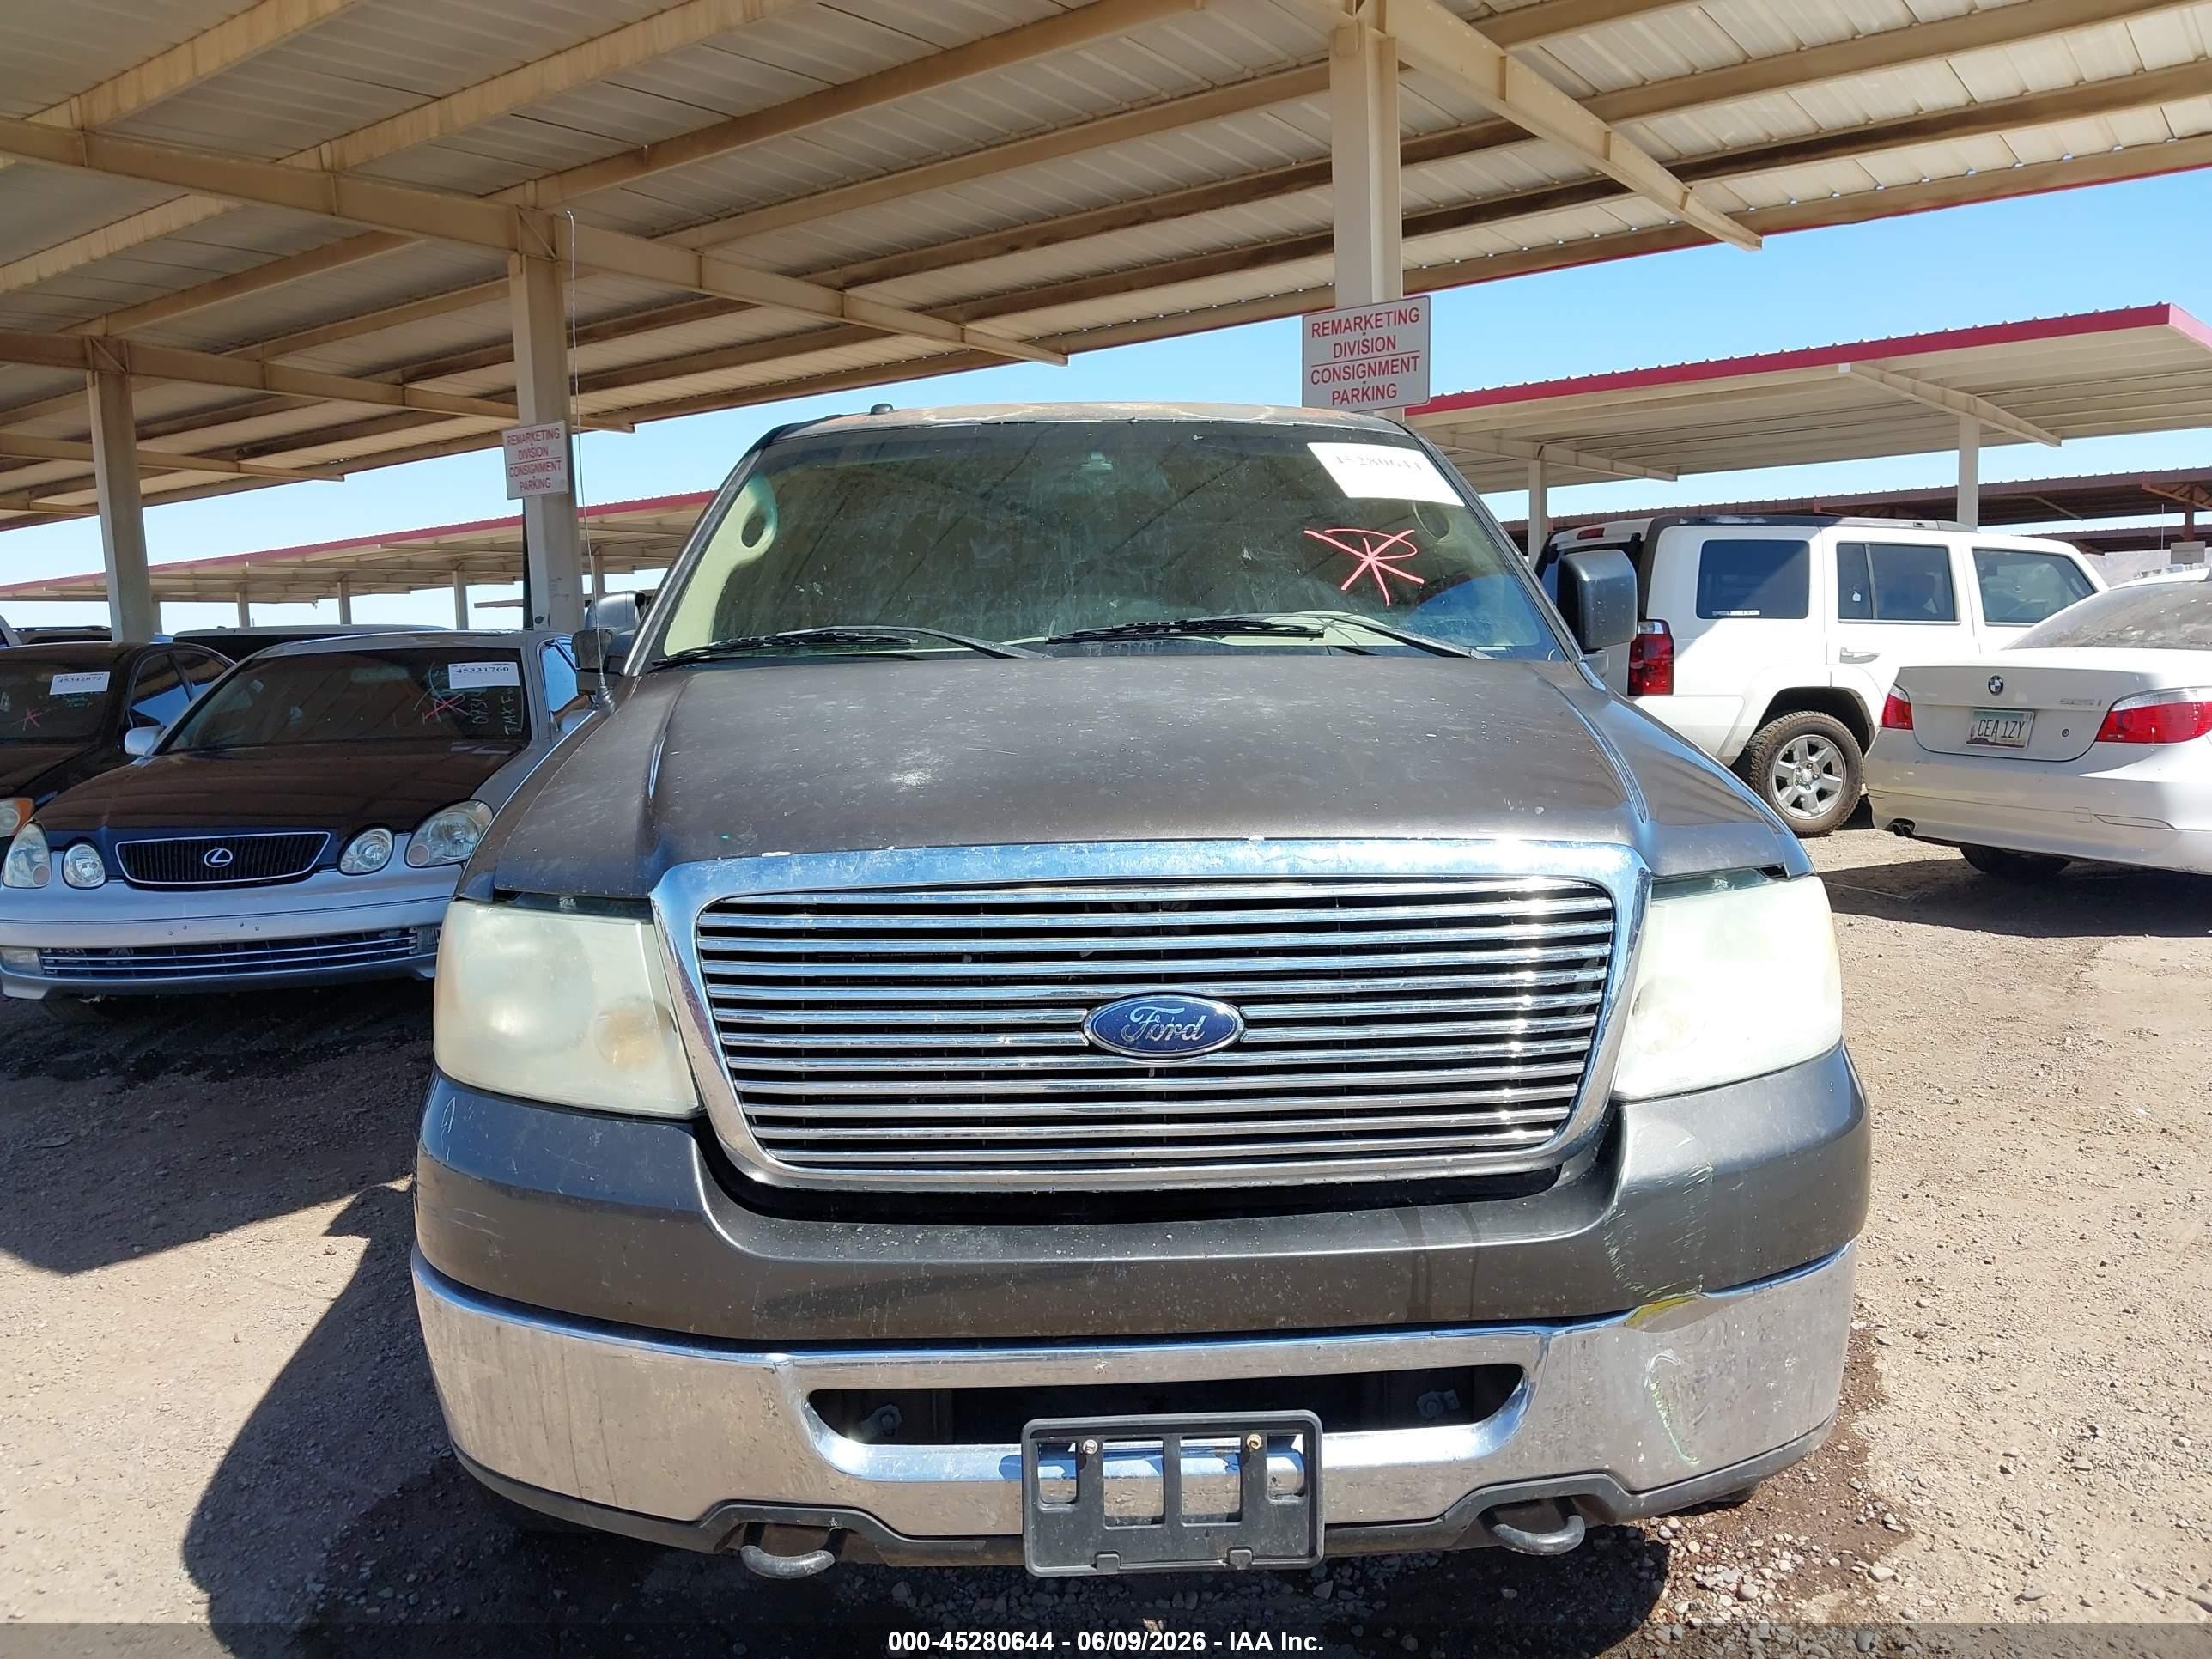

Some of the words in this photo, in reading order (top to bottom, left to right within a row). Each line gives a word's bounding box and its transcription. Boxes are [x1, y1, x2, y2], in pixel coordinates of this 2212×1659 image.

[1311, 307, 1419, 338] REMARKETING
[1333, 335, 1397, 358] DIVISION
[1310, 356, 1420, 385] CONSIGNMENT
[1332, 383, 1397, 406] PARKING
[507, 428, 560, 446] REMARKETING
[518, 446, 550, 460] DIVISION
[509, 459, 562, 477] CONSIGNMENT
[520, 477, 551, 492] PARKING
[1978, 719, 2000, 738] CEA
[2001, 720, 2025, 738] 1ZY
[1121, 1006, 1208, 1042] Ford
